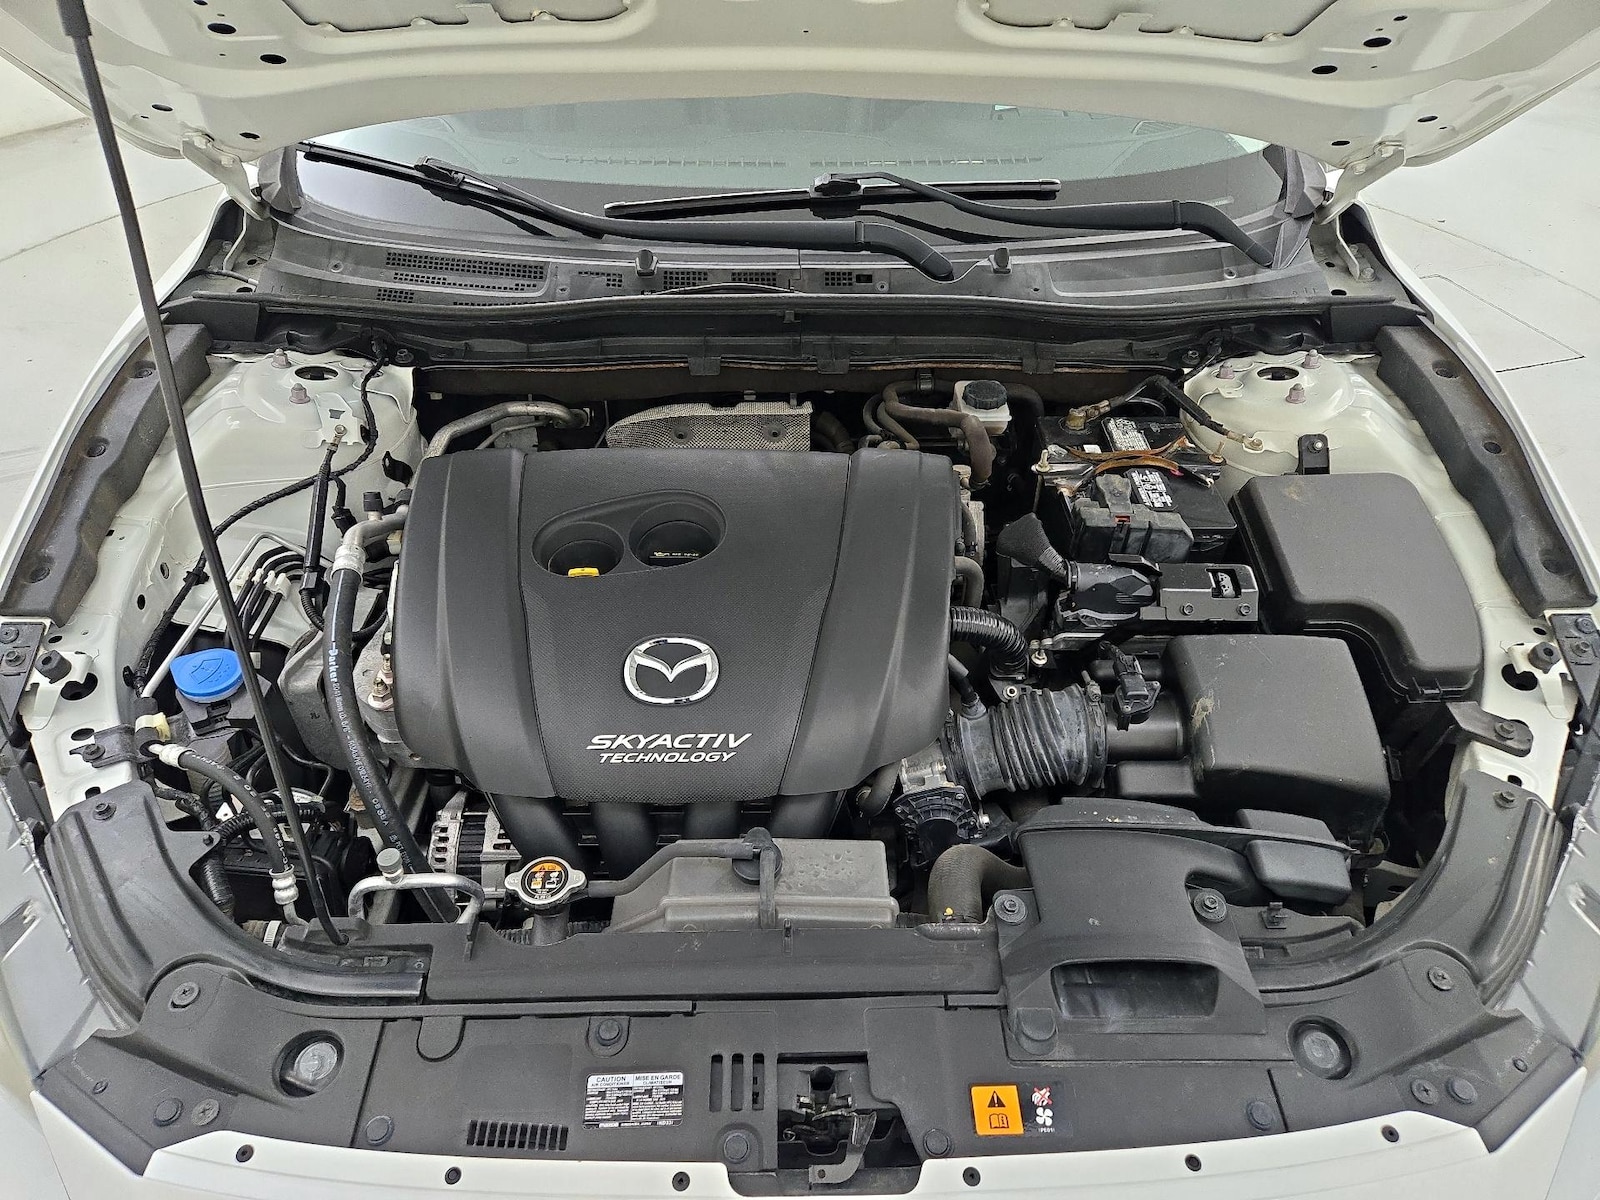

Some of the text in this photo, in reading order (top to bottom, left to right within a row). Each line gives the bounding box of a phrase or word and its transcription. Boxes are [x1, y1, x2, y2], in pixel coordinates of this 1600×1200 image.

[328, 649, 339, 682] Parker
[586, 733, 753, 750] SKYACTIV
[599, 751, 737, 764] TECHNOLOGY
